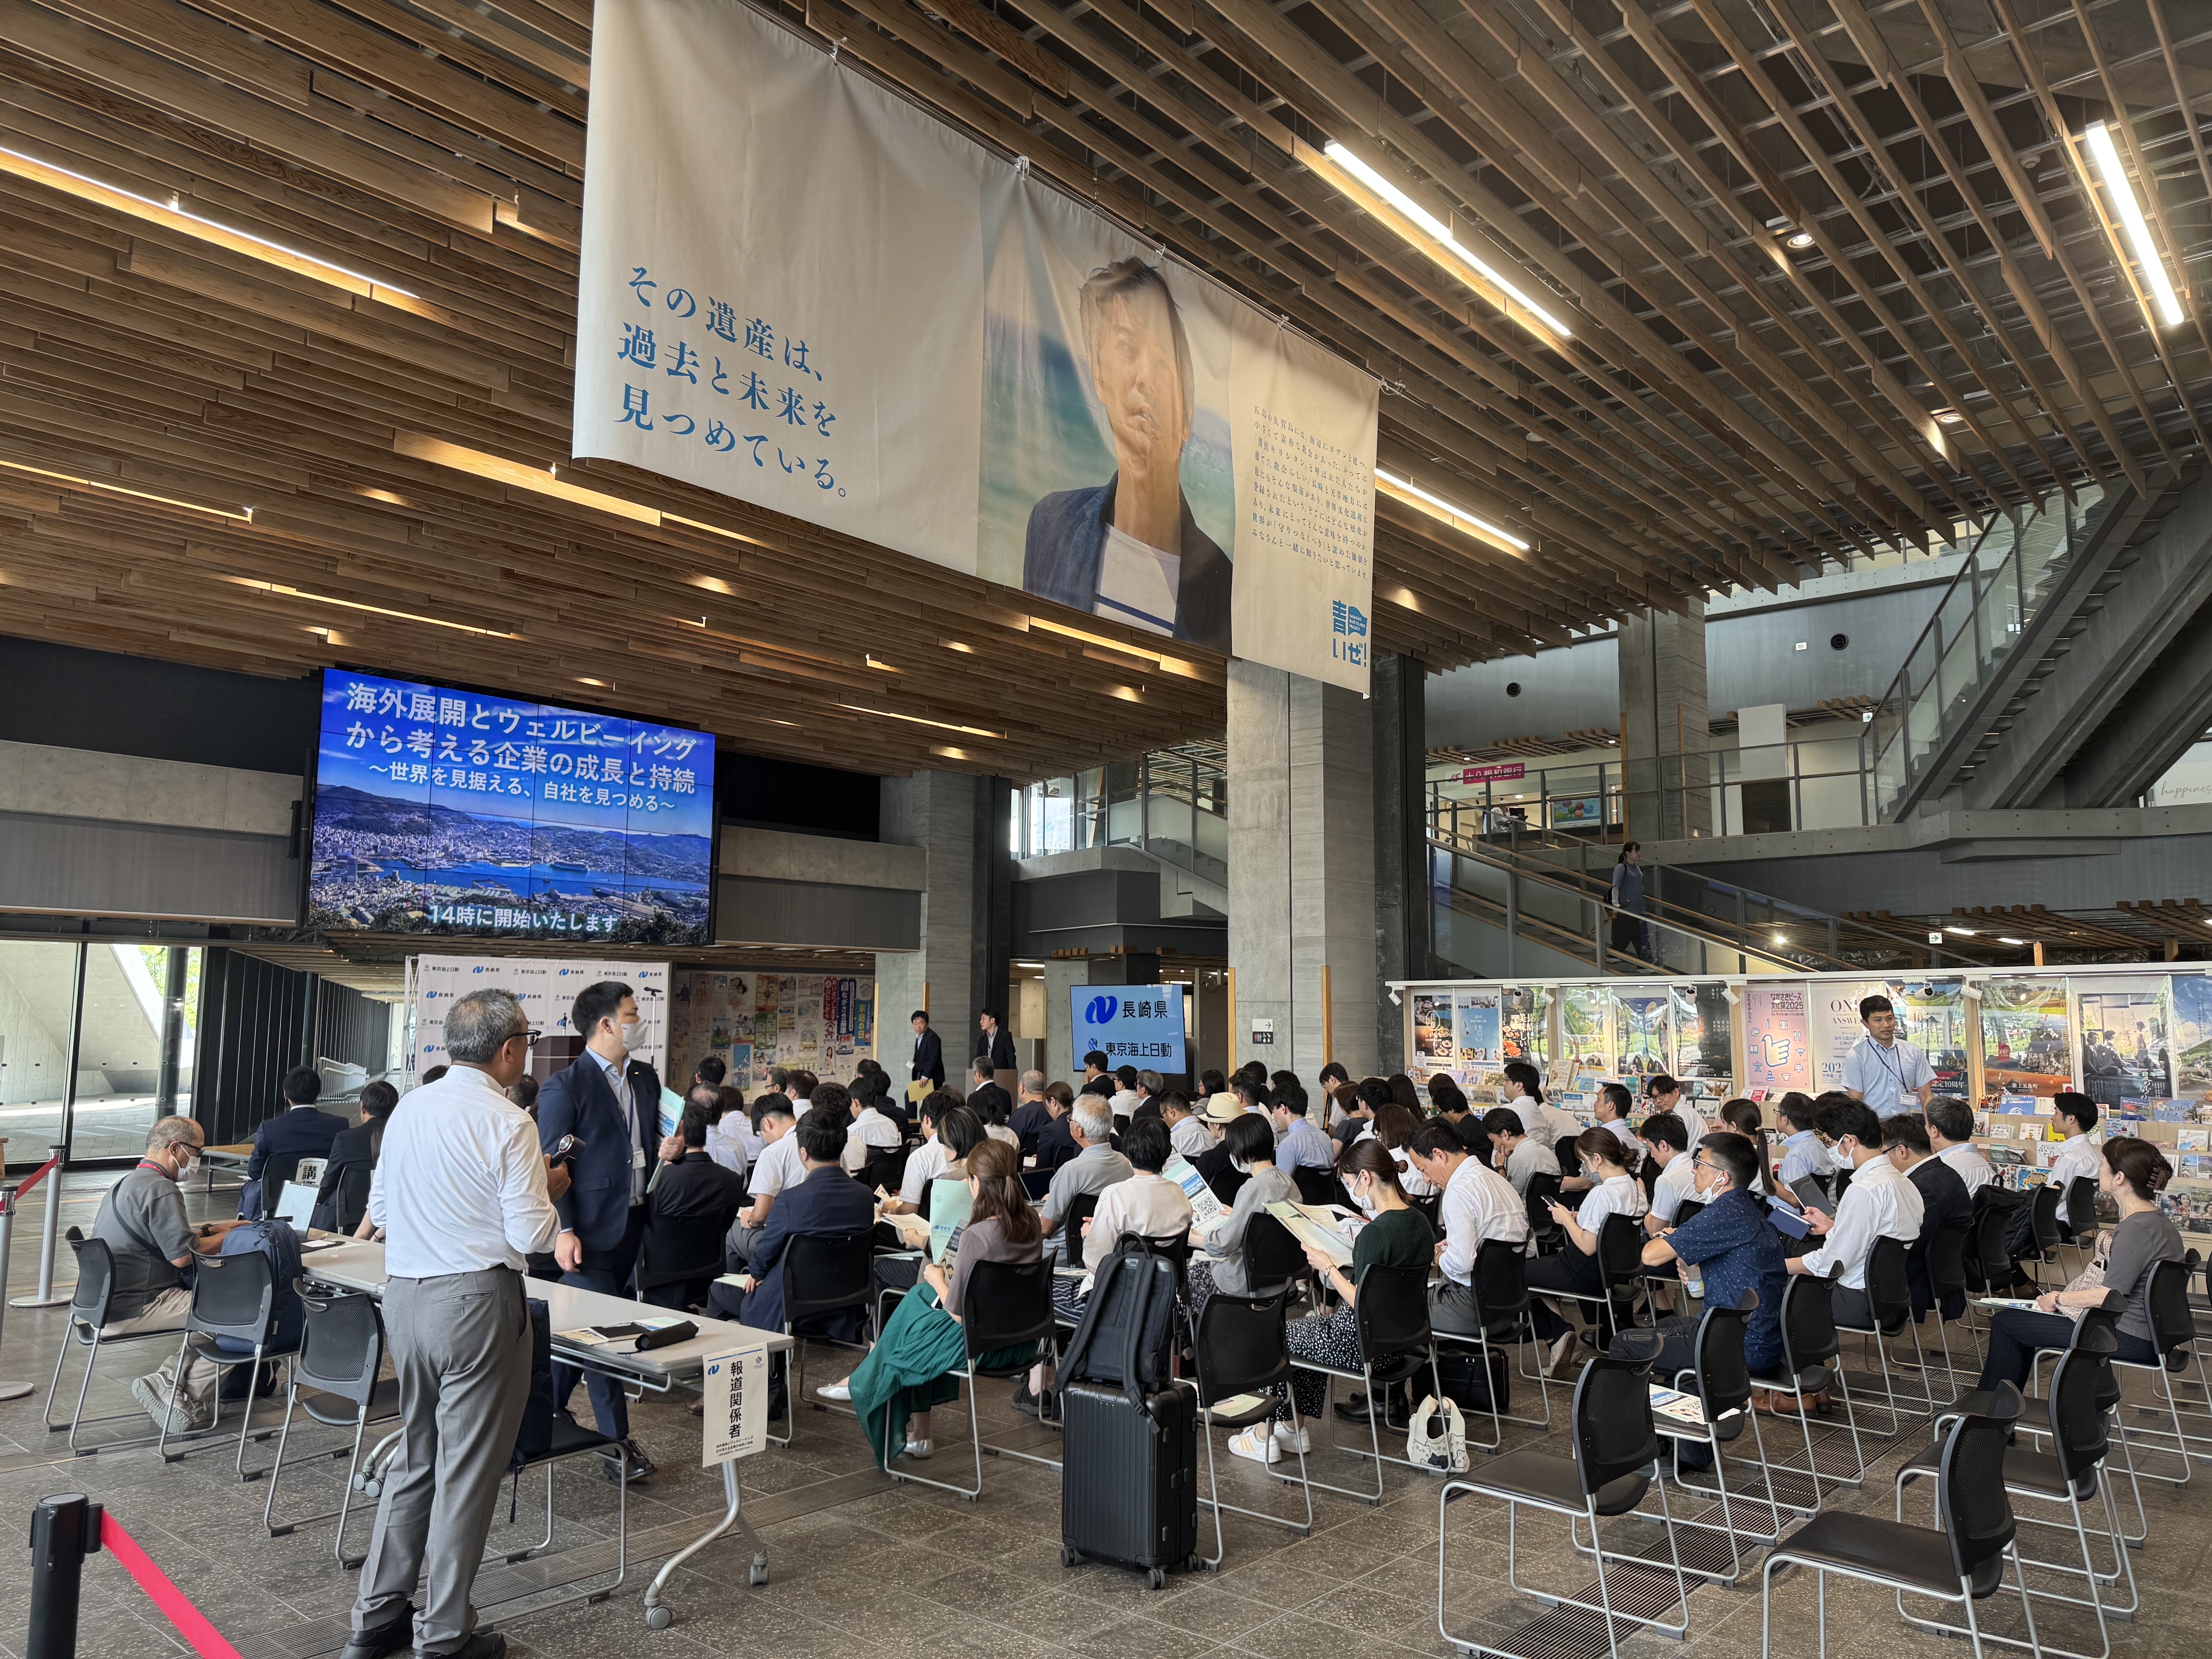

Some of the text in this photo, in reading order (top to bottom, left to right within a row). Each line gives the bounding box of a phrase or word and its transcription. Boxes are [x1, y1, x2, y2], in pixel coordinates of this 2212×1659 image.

[629, 267, 822, 381] その遺産は、
[617, 322, 836, 437] 過去と未来を
[613, 383, 846, 497] 見つめている。
[346, 721, 696, 794] から考える企業の成長と持続
[347, 682, 697, 761] 海外展開とウェルビーイング
[429, 904, 618, 933] 14時に開始いたします
[1122, 1000, 1168, 1018] 長崎県
[1771, 993, 1802, 1001] ながさきピース
[1771, 1001, 1803, 1010] 文化祭2025
[1105, 1042, 1171, 1058] 東京海上日動
[728, 1360, 743, 1439] 報道関係者
